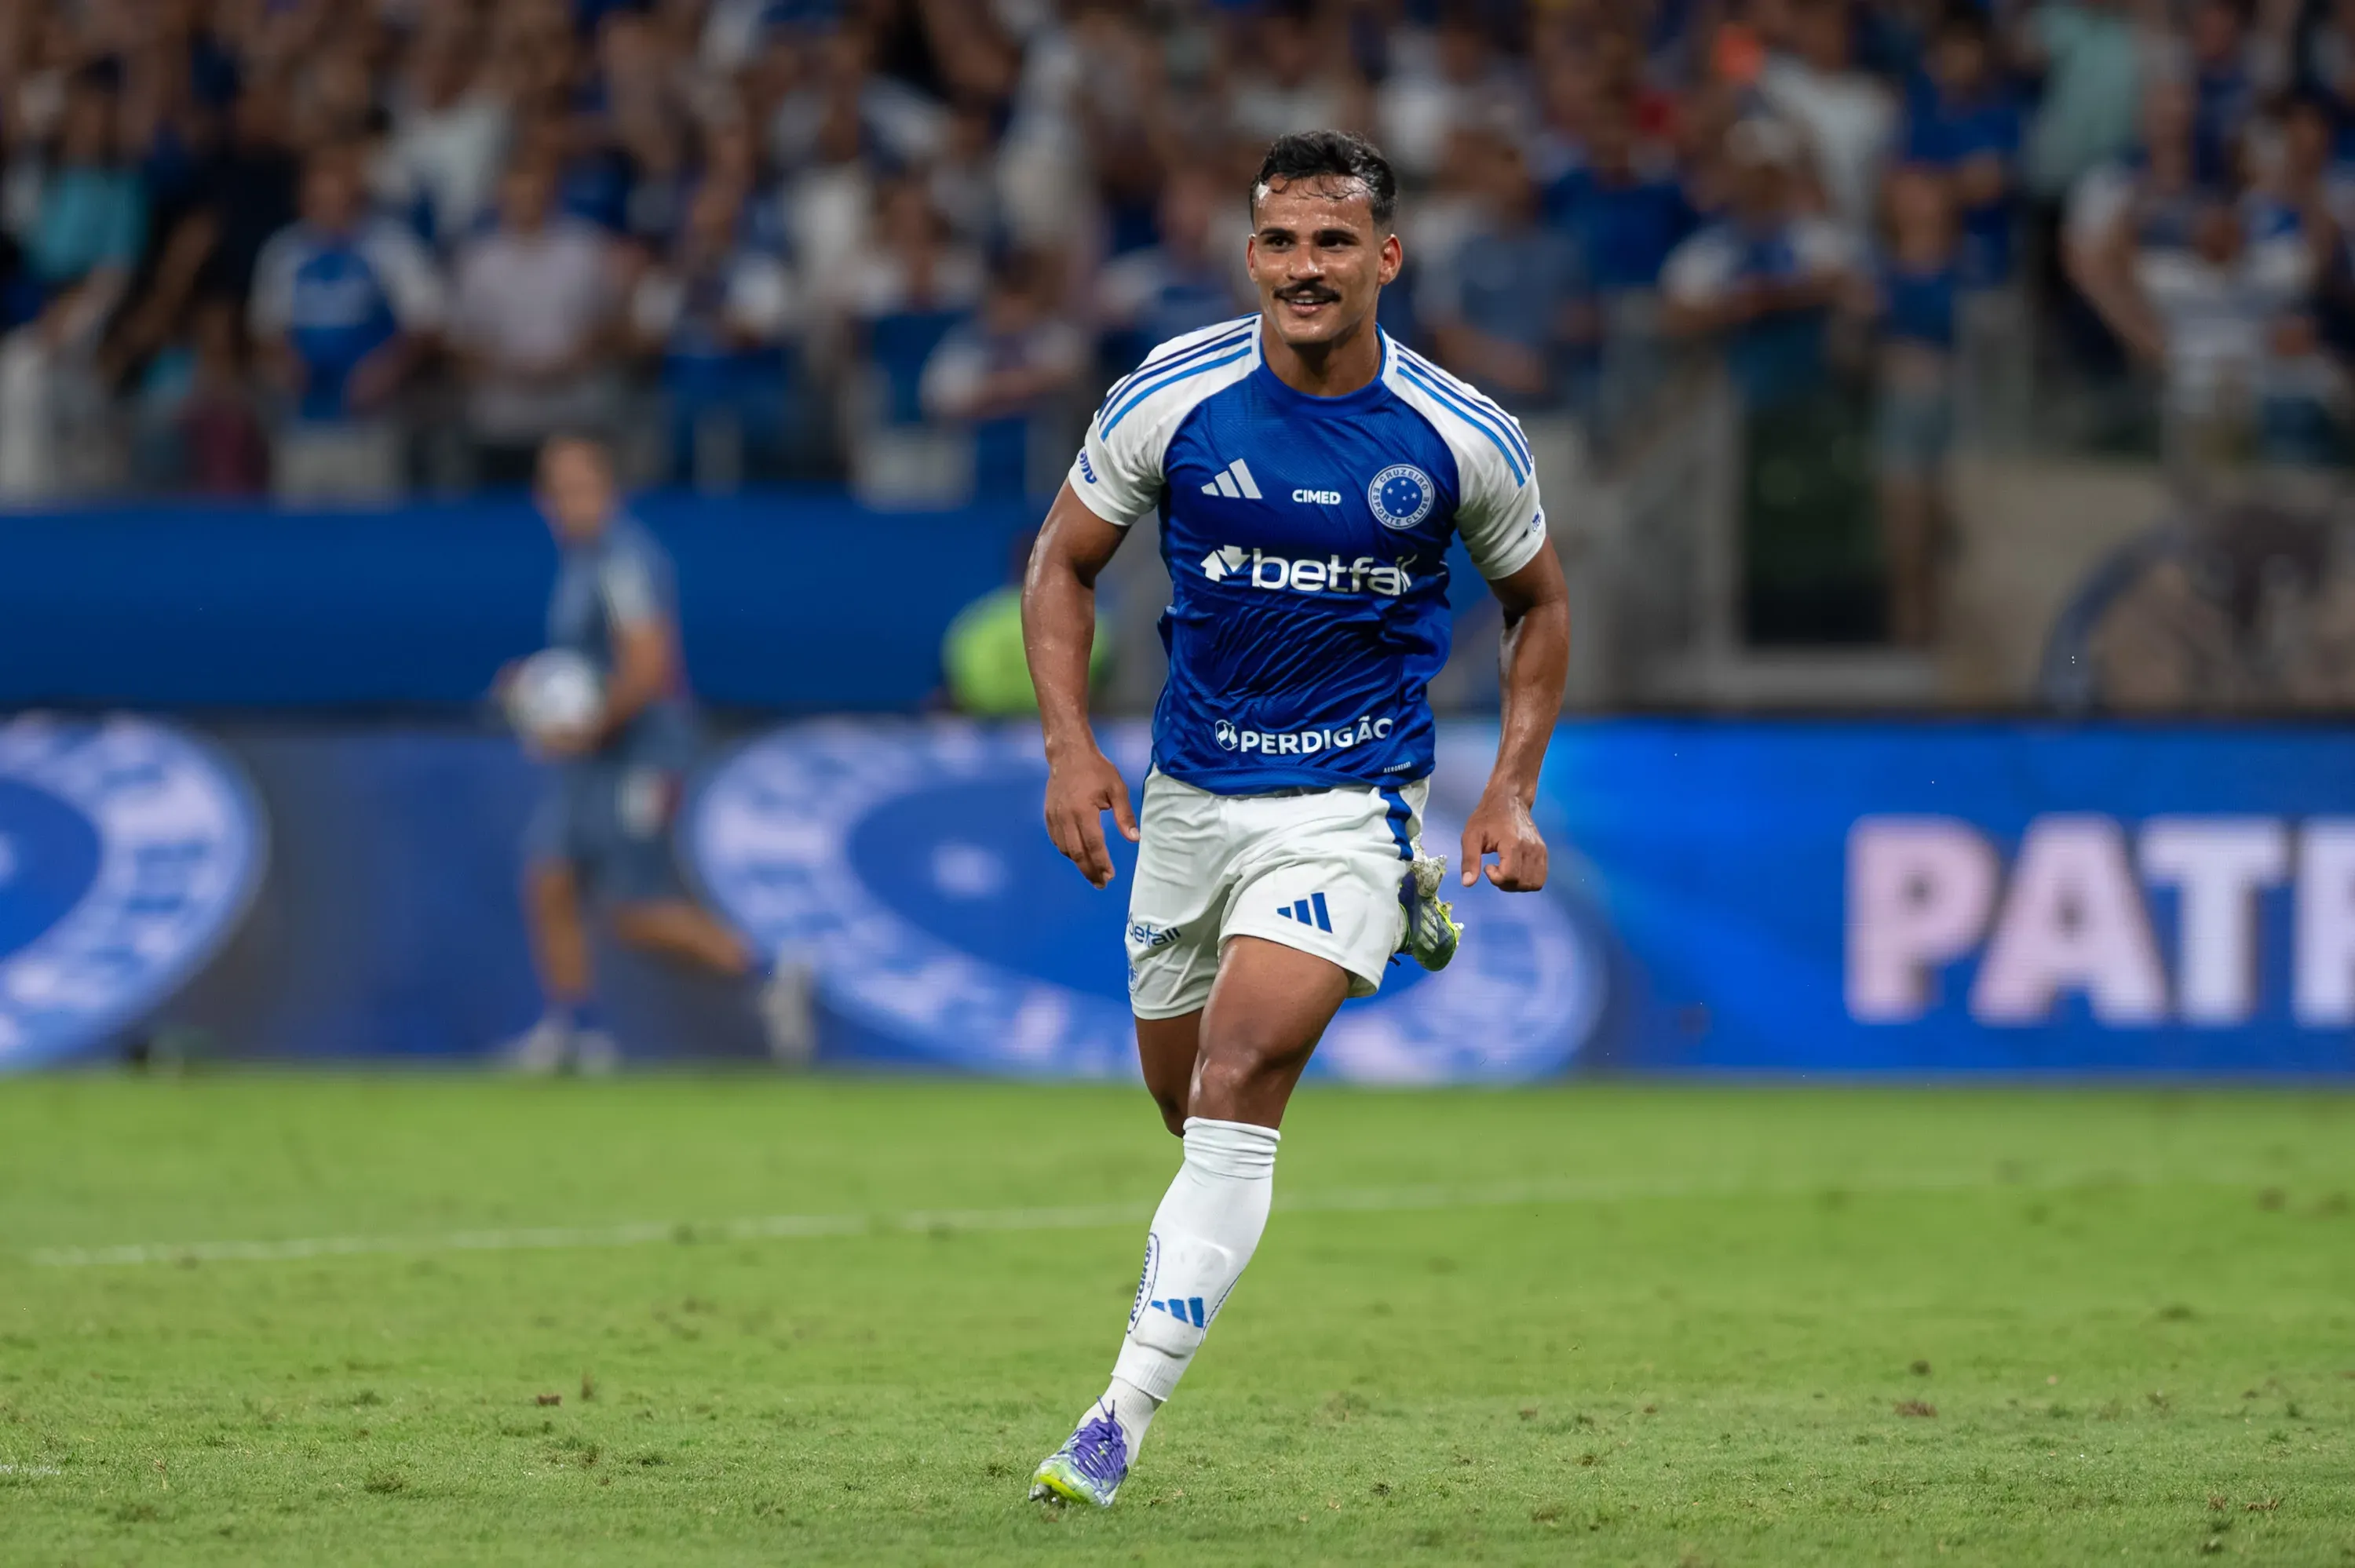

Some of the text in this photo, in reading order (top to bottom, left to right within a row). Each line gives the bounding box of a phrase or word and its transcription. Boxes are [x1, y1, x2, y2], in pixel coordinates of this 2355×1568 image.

[1379, 469, 1428, 490] CRUZEIRO
[1292, 490, 1341, 505] CIMED
[1373, 487, 1429, 525] ESPORTE CLUBE
[1240, 716, 1393, 754] PERDIGÃO
